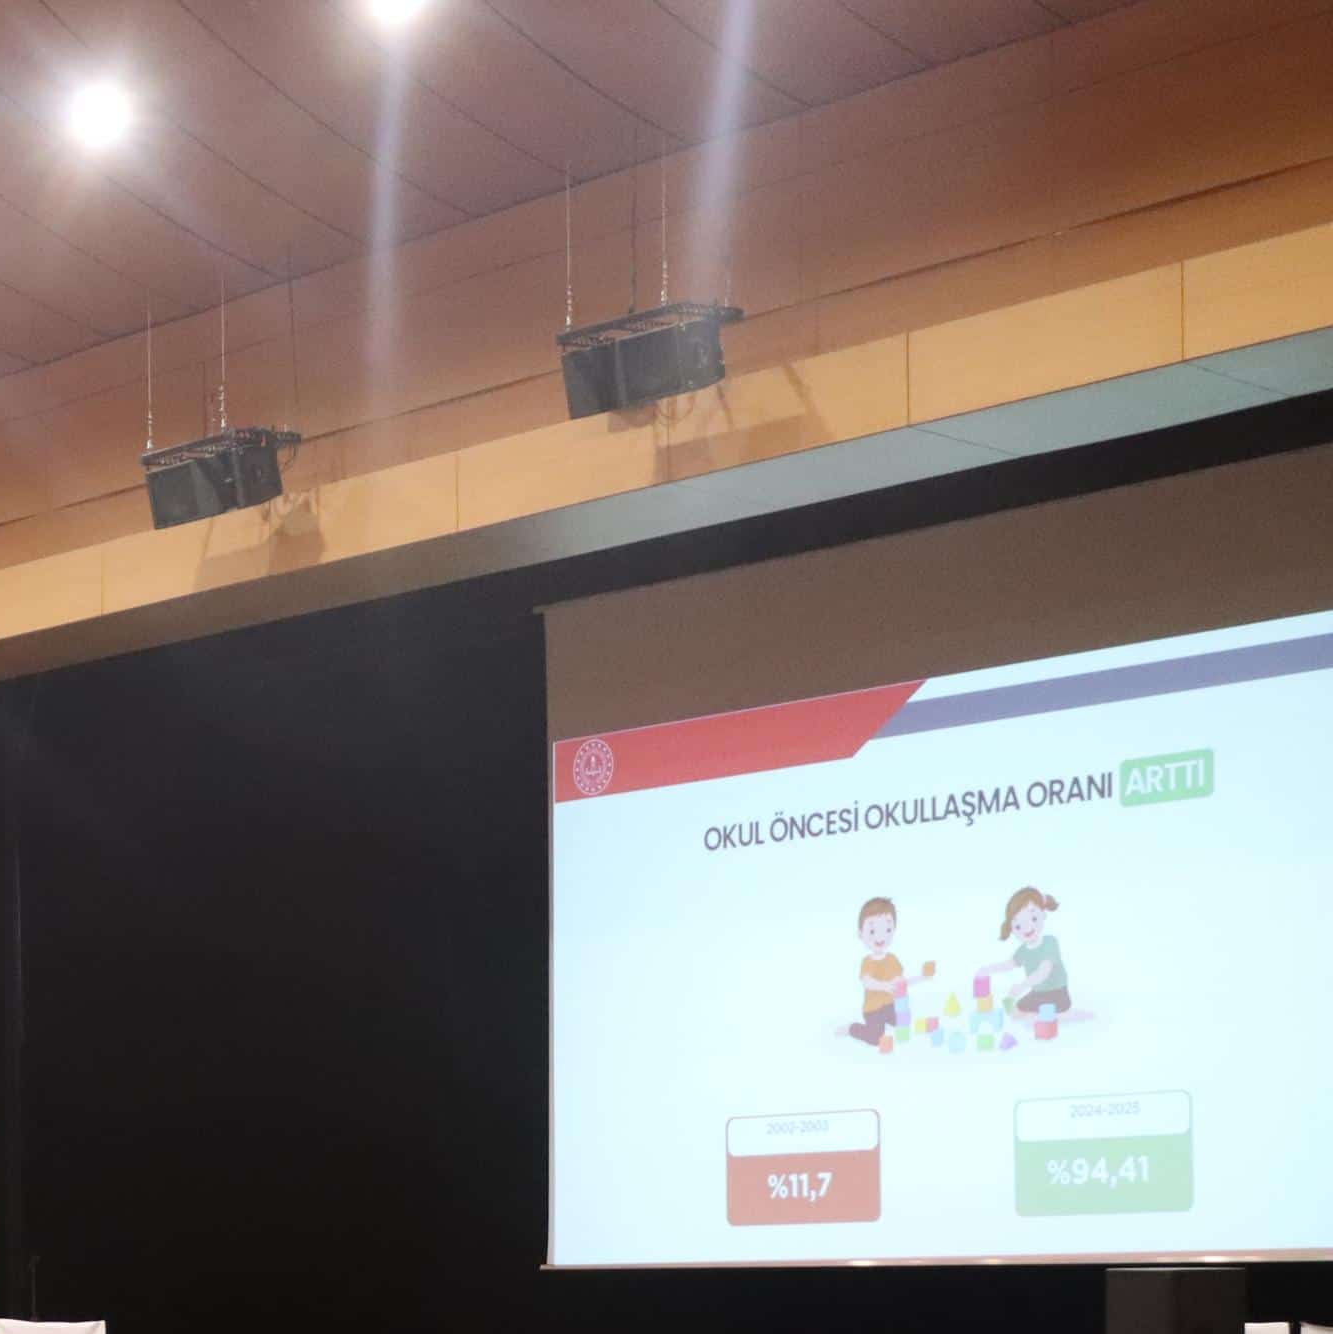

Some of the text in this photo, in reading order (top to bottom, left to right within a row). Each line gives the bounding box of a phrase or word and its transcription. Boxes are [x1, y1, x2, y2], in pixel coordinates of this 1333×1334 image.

[703, 758, 1206, 851] OKUL ÖNCESİ OKULLAŞMA ORANI ARTTI
[1068, 1100, 1142, 1119] 2024-2025
[767, 1171, 833, 1202] %11,7
[1045, 1154, 1150, 1190] %94,41
